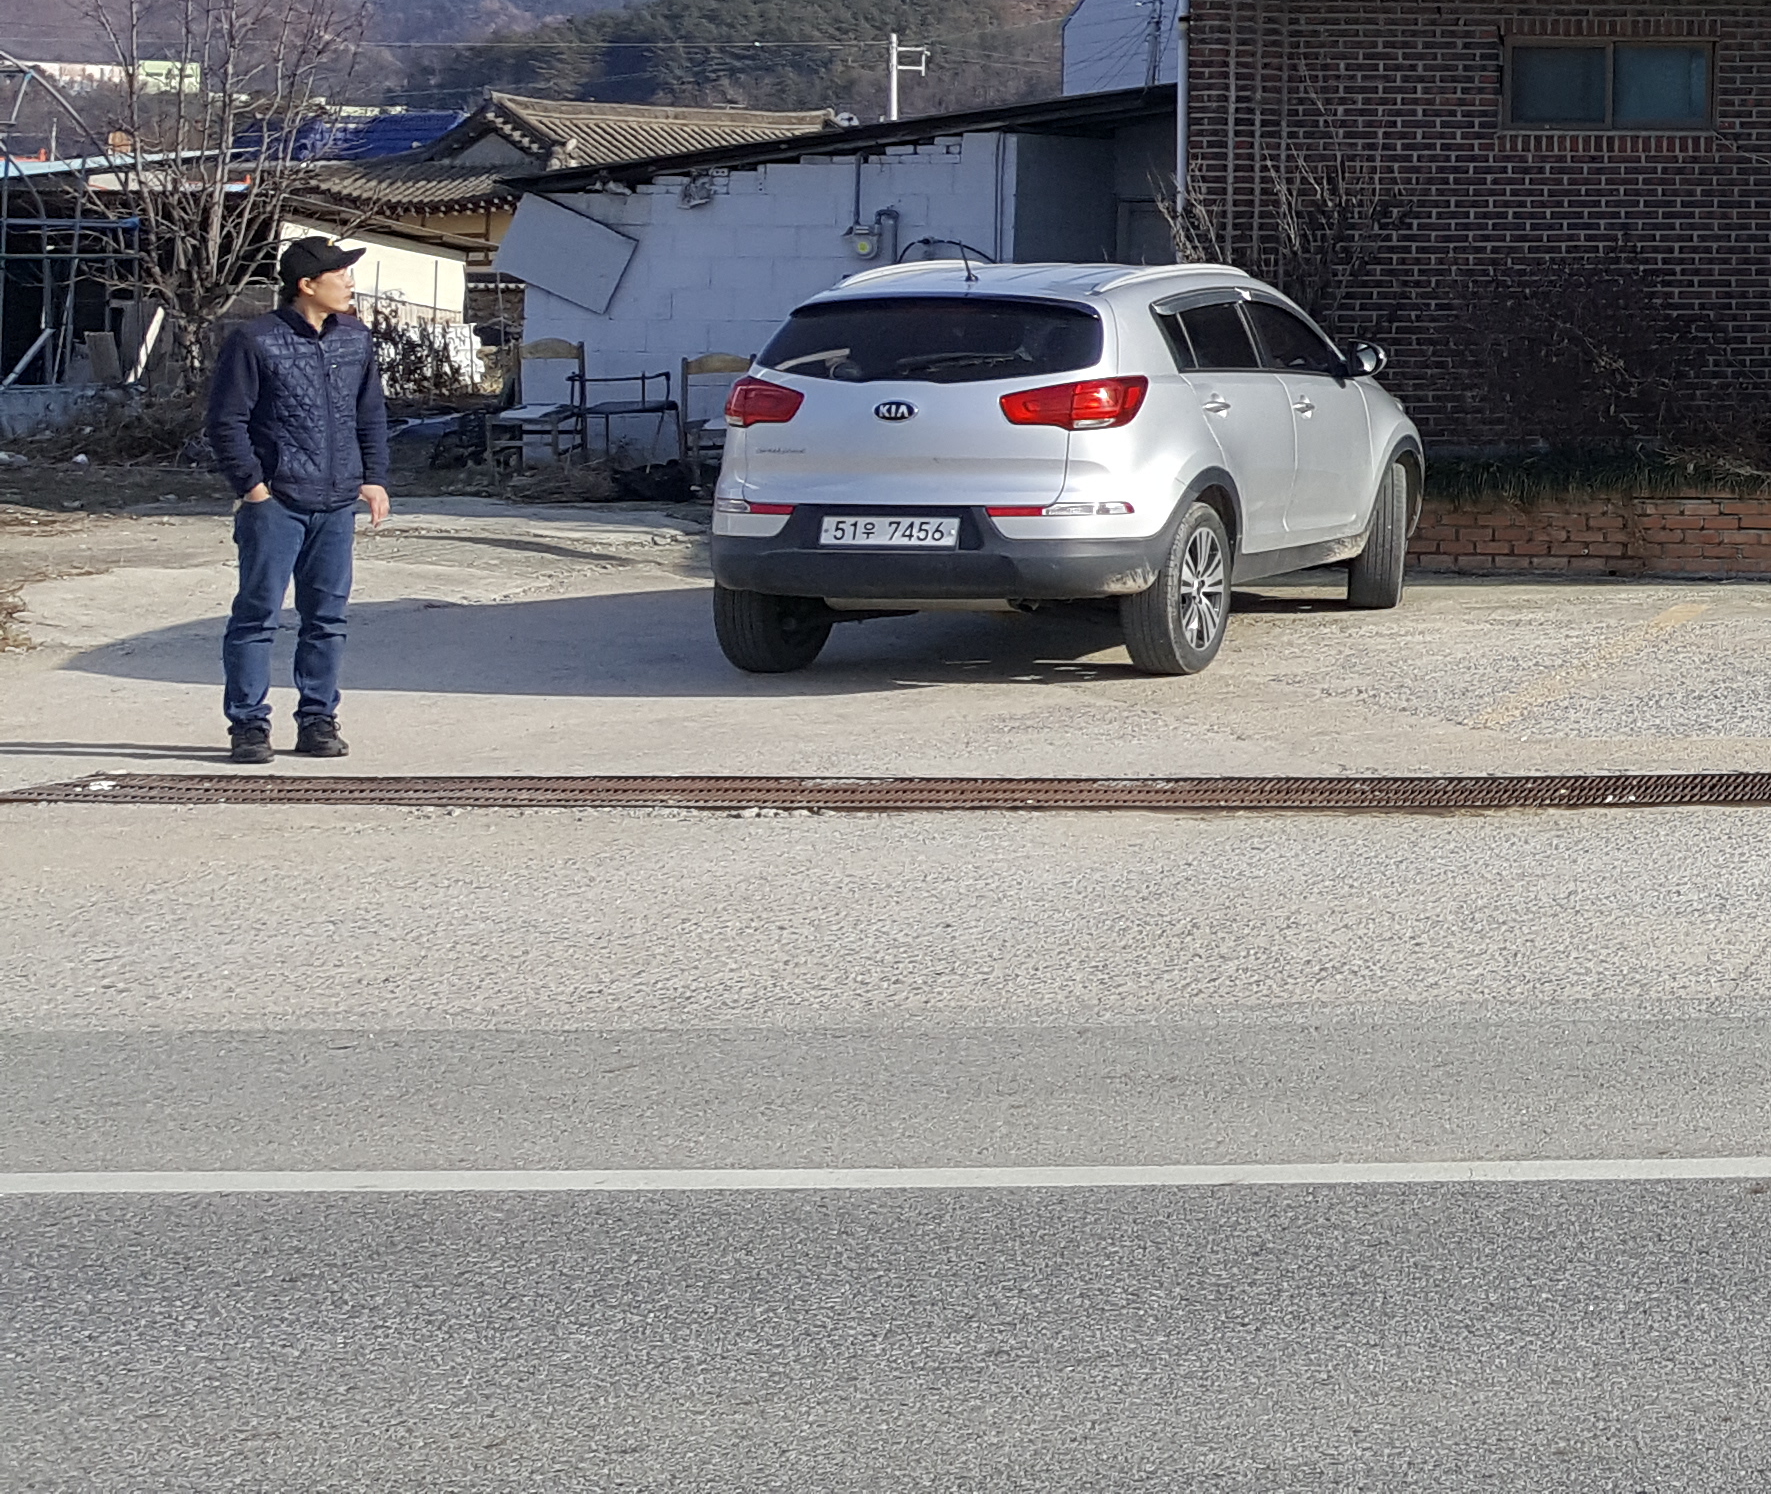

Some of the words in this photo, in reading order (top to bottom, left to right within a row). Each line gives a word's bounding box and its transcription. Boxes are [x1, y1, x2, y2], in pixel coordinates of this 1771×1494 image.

[878, 404, 909, 417] KIA
[833, 520, 875, 540] 51우
[888, 521, 945, 541] 7456
